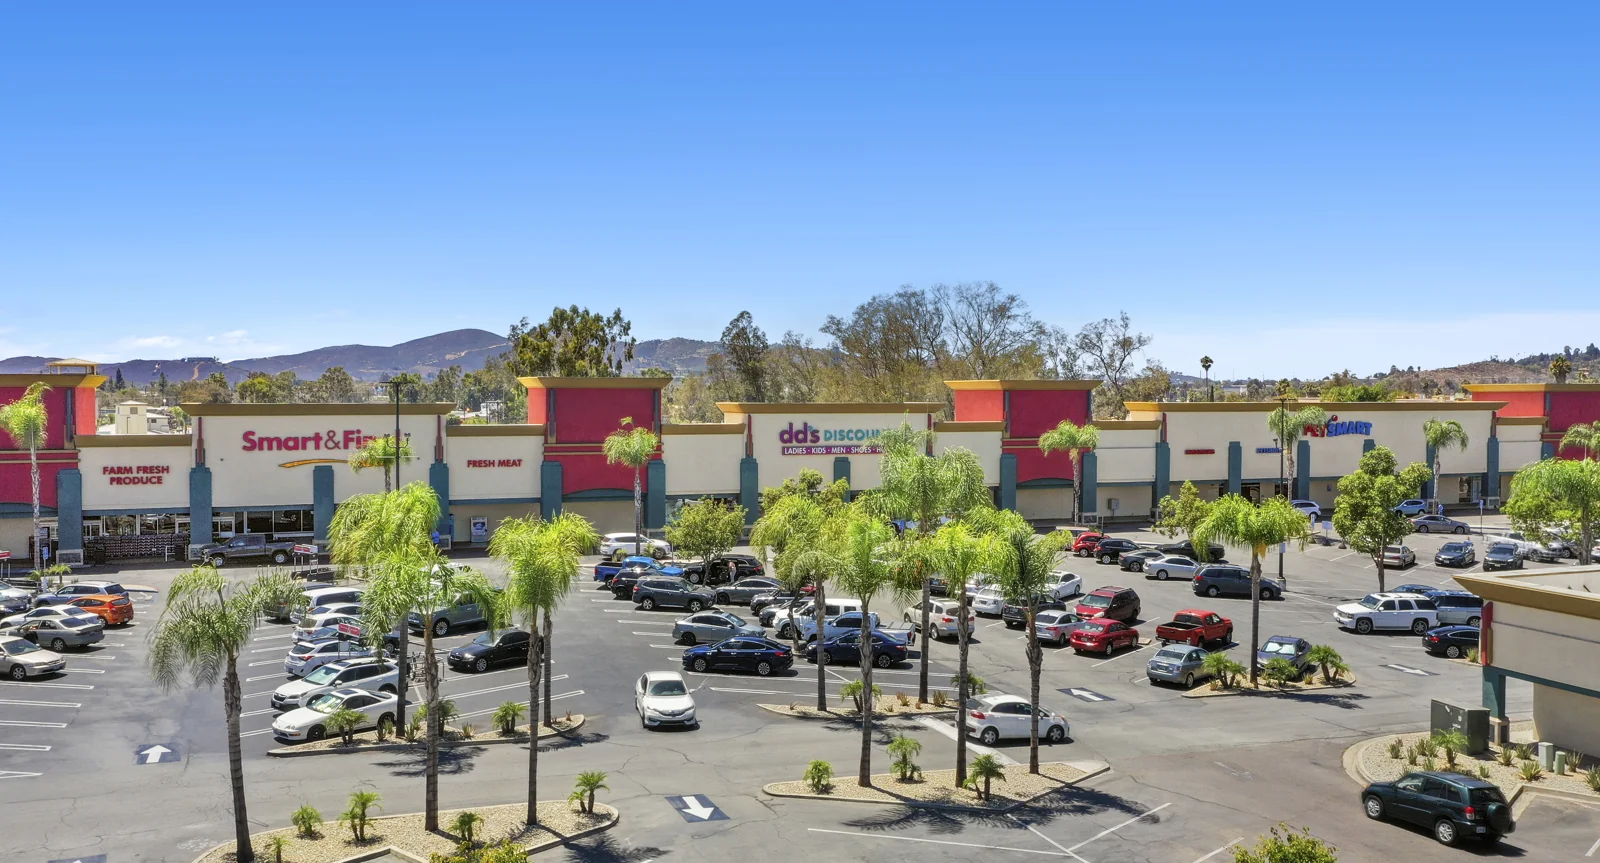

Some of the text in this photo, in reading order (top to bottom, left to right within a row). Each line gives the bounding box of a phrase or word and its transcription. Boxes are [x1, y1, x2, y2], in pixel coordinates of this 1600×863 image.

[780, 422, 880, 444] dd's DISCOU
[811, 446, 827, 454] KIDS
[831, 446, 846, 454] MEN
[850, 446, 872, 454] SHOES
[467, 459, 523, 468] FRESH MEAT
[102, 465, 170, 475] FARM FRESH
[109, 476, 163, 485] PRODUCE
